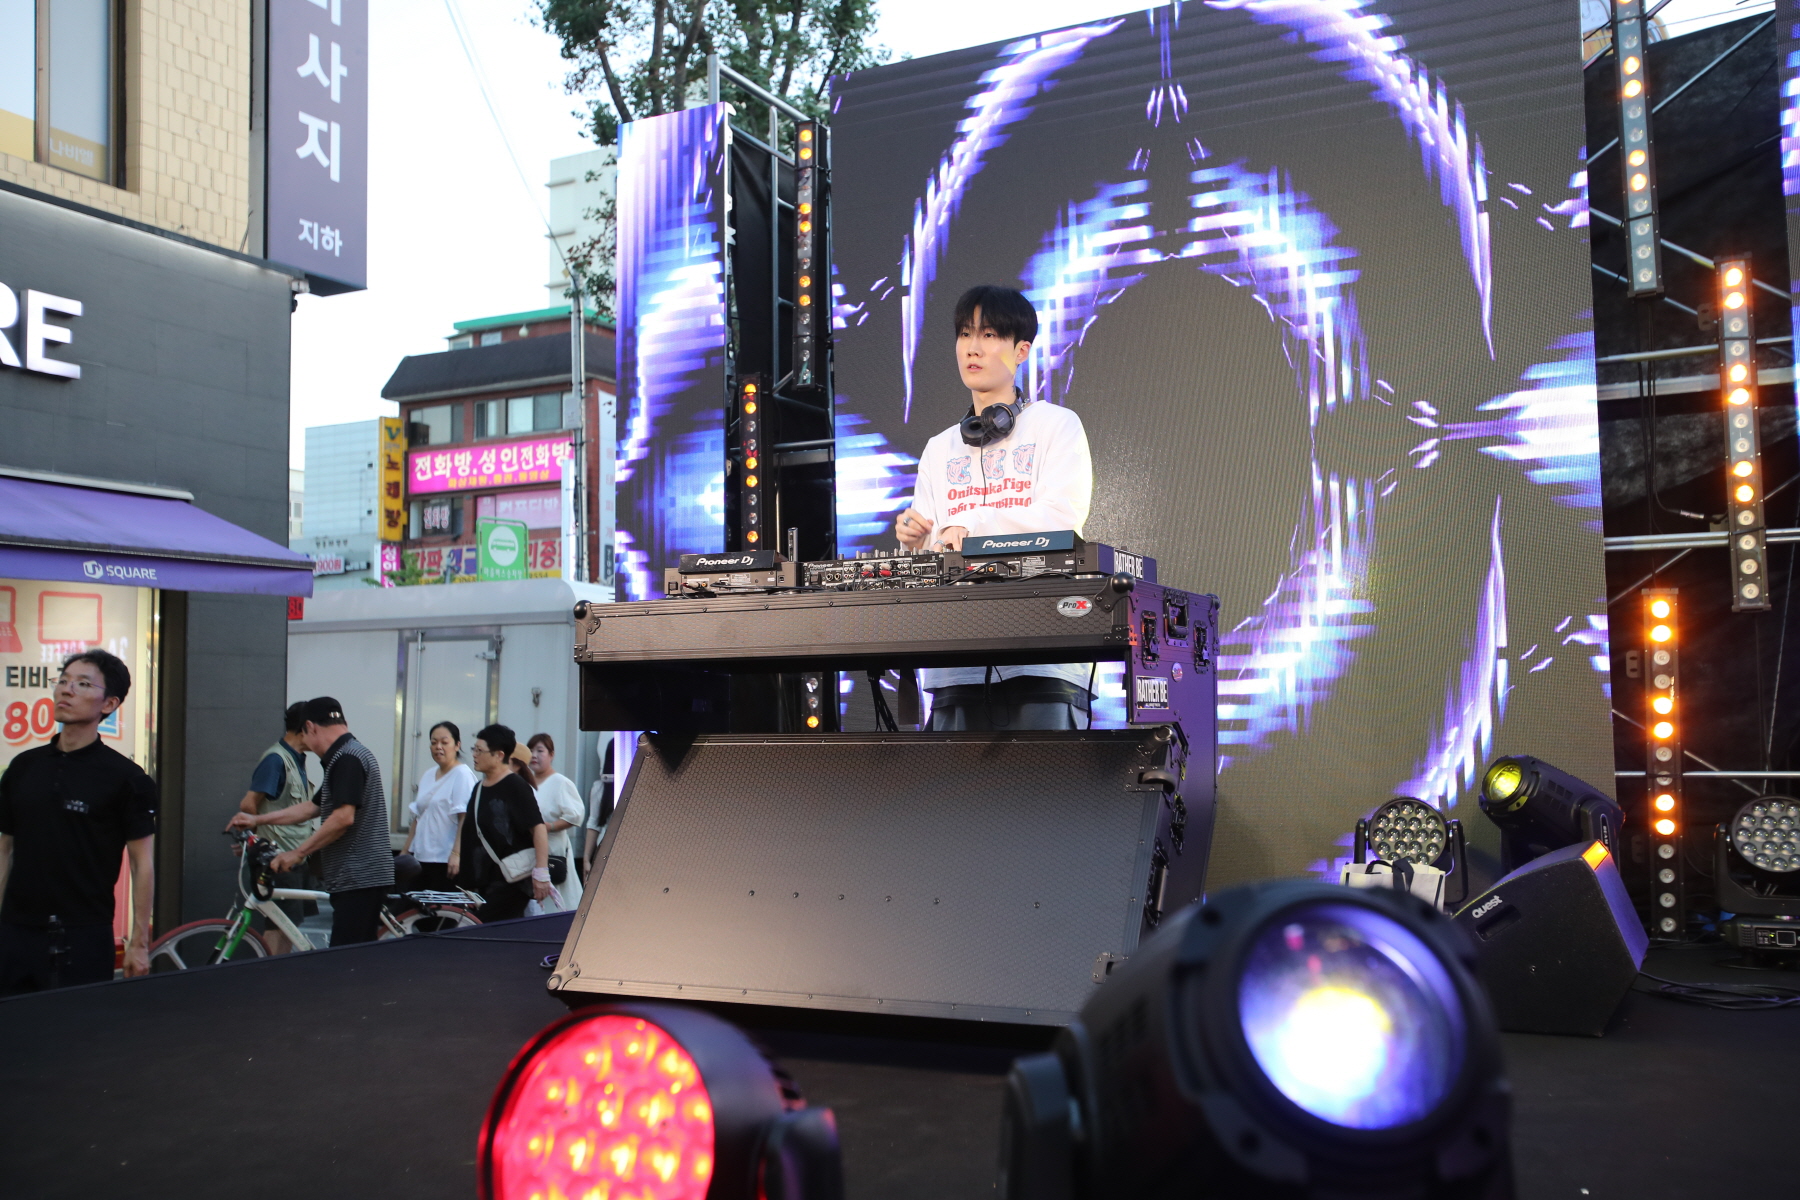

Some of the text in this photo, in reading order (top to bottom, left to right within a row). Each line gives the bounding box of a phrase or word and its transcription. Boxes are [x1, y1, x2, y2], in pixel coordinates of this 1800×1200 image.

[298, 218, 343, 258] 지하
[982, 540, 1033, 549] Pioneer
[696, 557, 739, 566] Pioneer
[1114, 551, 1143, 579] RATHER BE
[106, 565, 157, 580] SQUARE
[1062, 600, 1088, 610] ProX
[6, 666, 48, 689] 티비
[1137, 678, 1168, 703] RATHER BE
